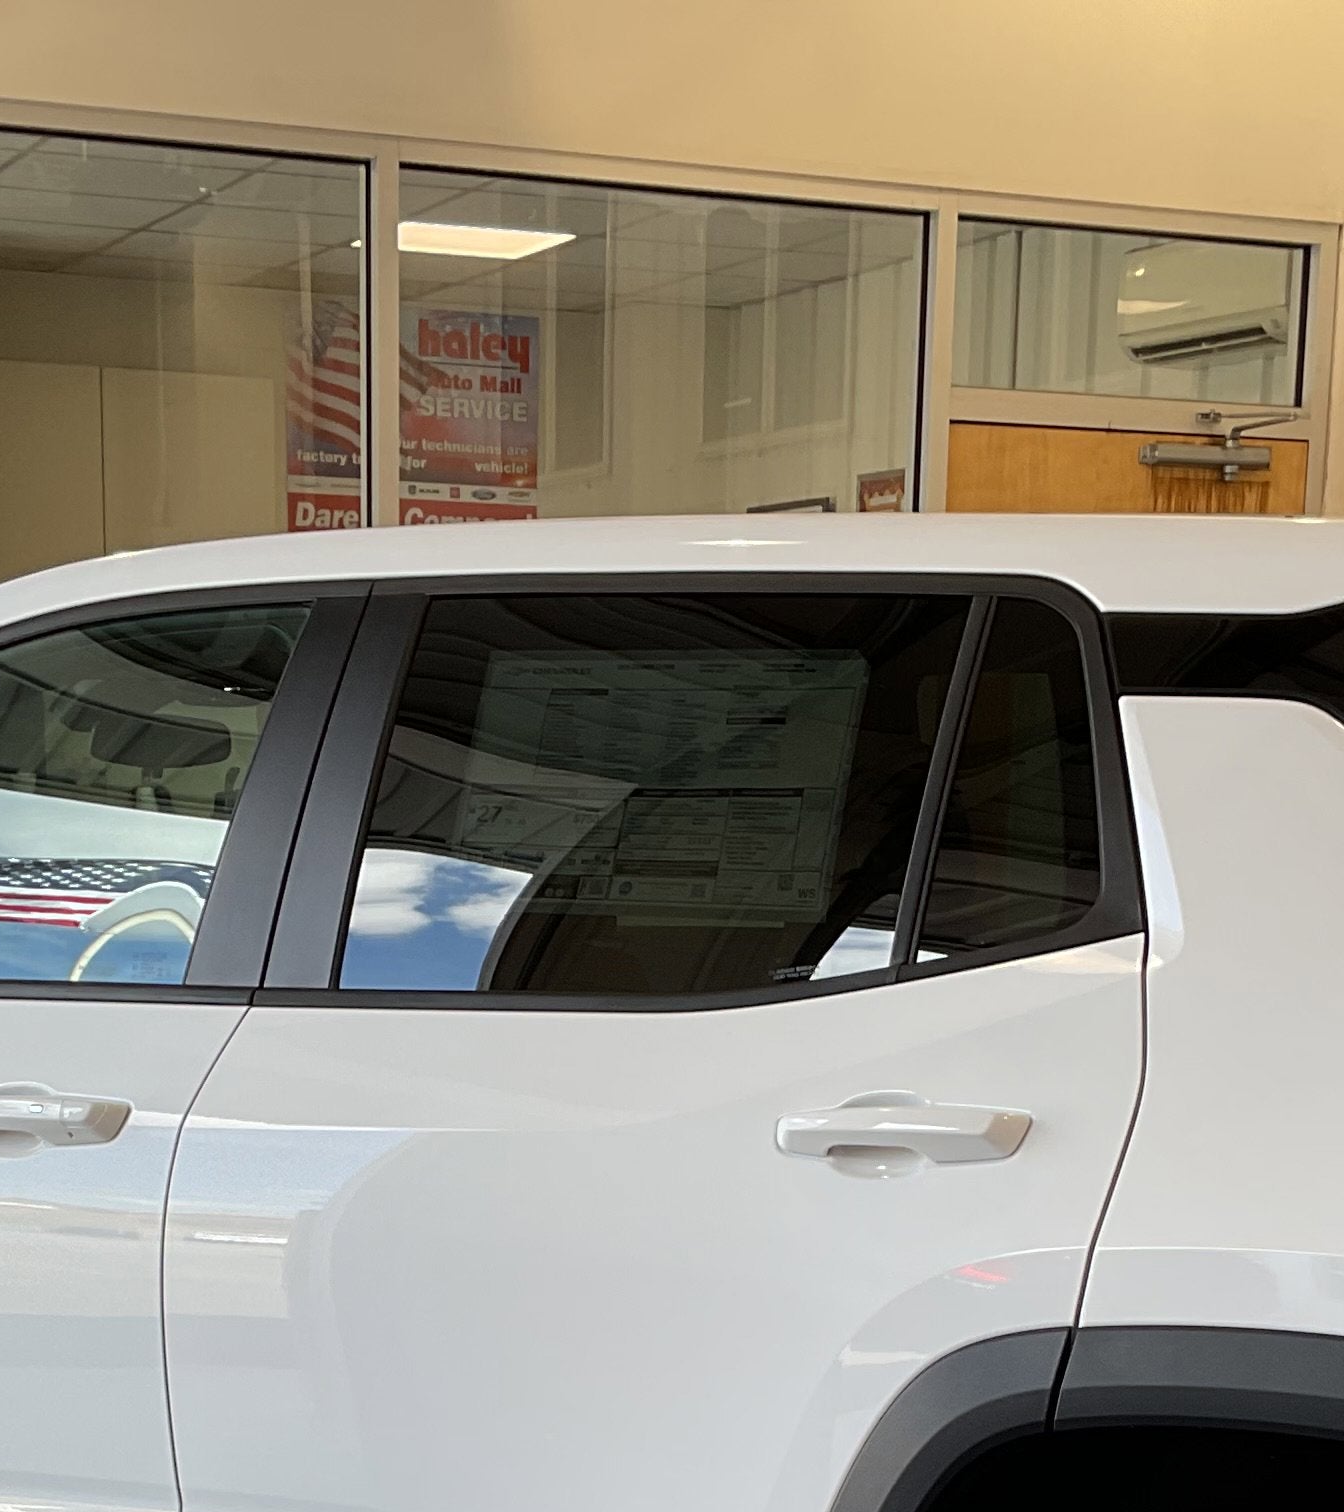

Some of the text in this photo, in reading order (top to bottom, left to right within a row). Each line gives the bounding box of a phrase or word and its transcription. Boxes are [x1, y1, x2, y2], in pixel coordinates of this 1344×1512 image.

[417, 318, 530, 373] haley
[479, 374, 523, 394] Mall
[417, 395, 529, 422] SERVICE
[296, 448, 348, 467] factory
[474, 461, 529, 475] vehicle!
[400, 439, 417, 450] ur
[506, 445, 529, 457] are
[295, 500, 360, 529] Dare
